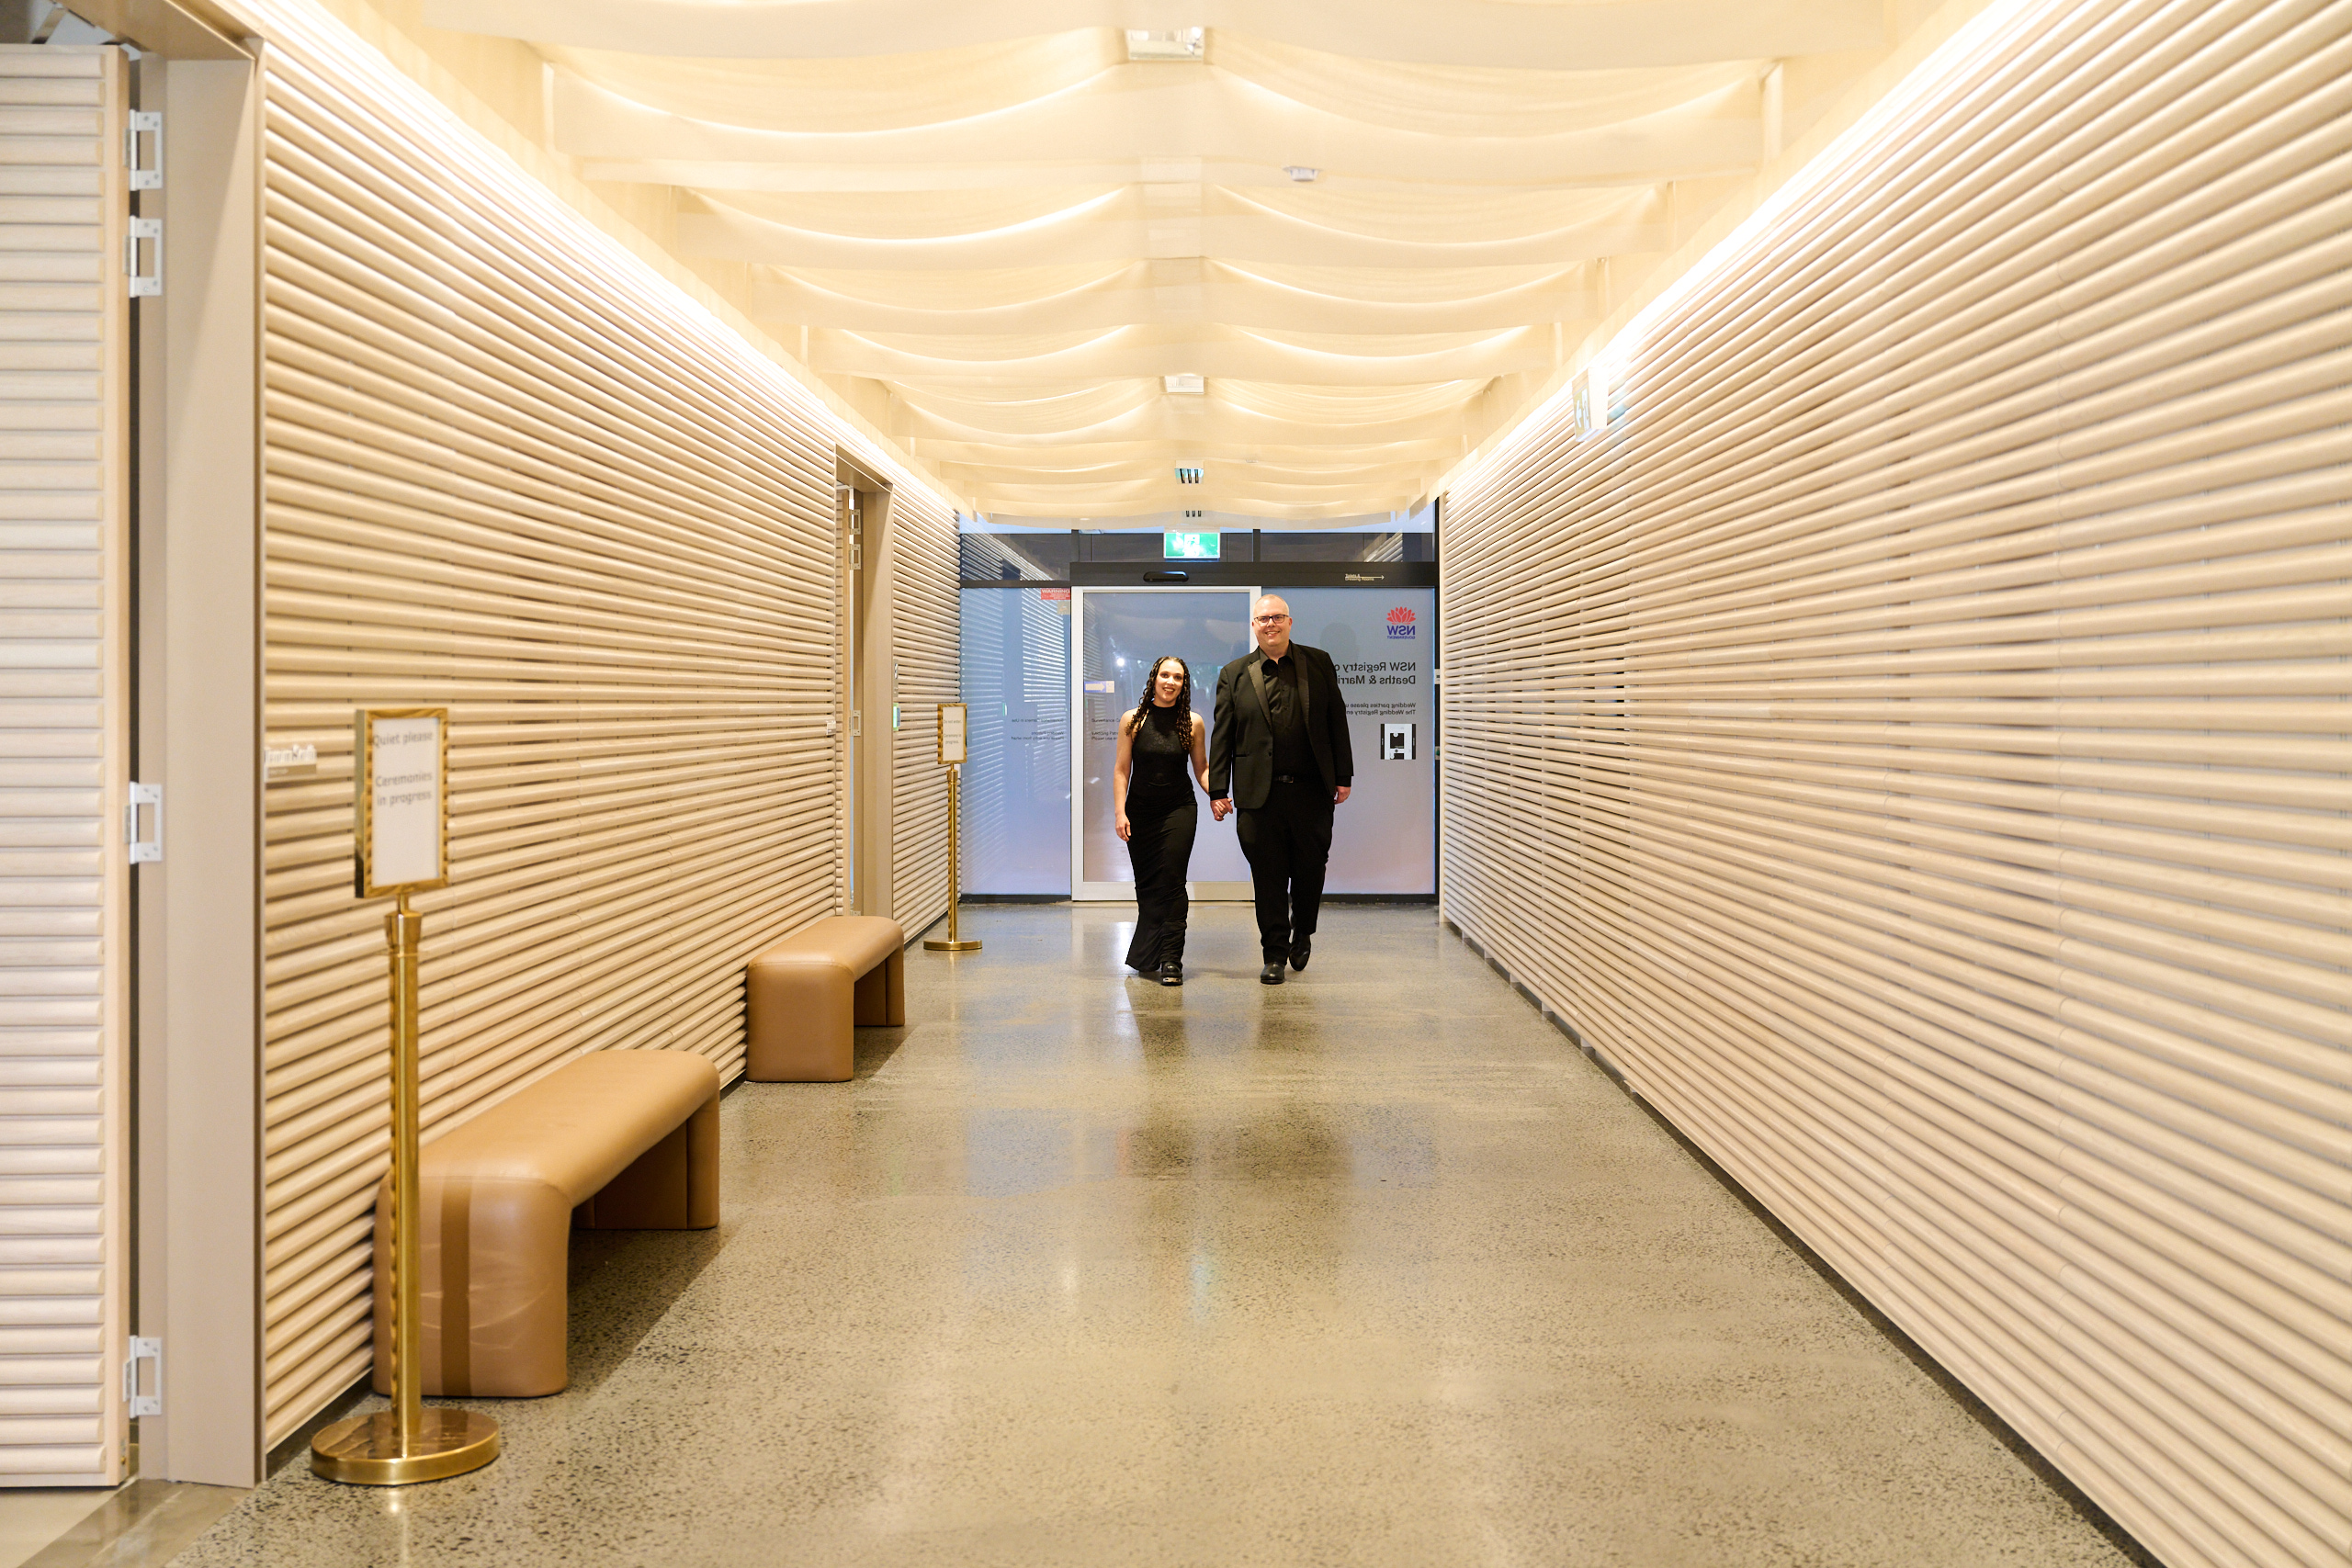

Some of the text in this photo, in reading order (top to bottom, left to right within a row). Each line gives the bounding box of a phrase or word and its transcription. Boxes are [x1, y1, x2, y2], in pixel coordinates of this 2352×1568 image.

[372, 731, 433, 749] Quiet please
[375, 772, 433, 787] Ceremonies
[377, 791, 432, 808] in progress
